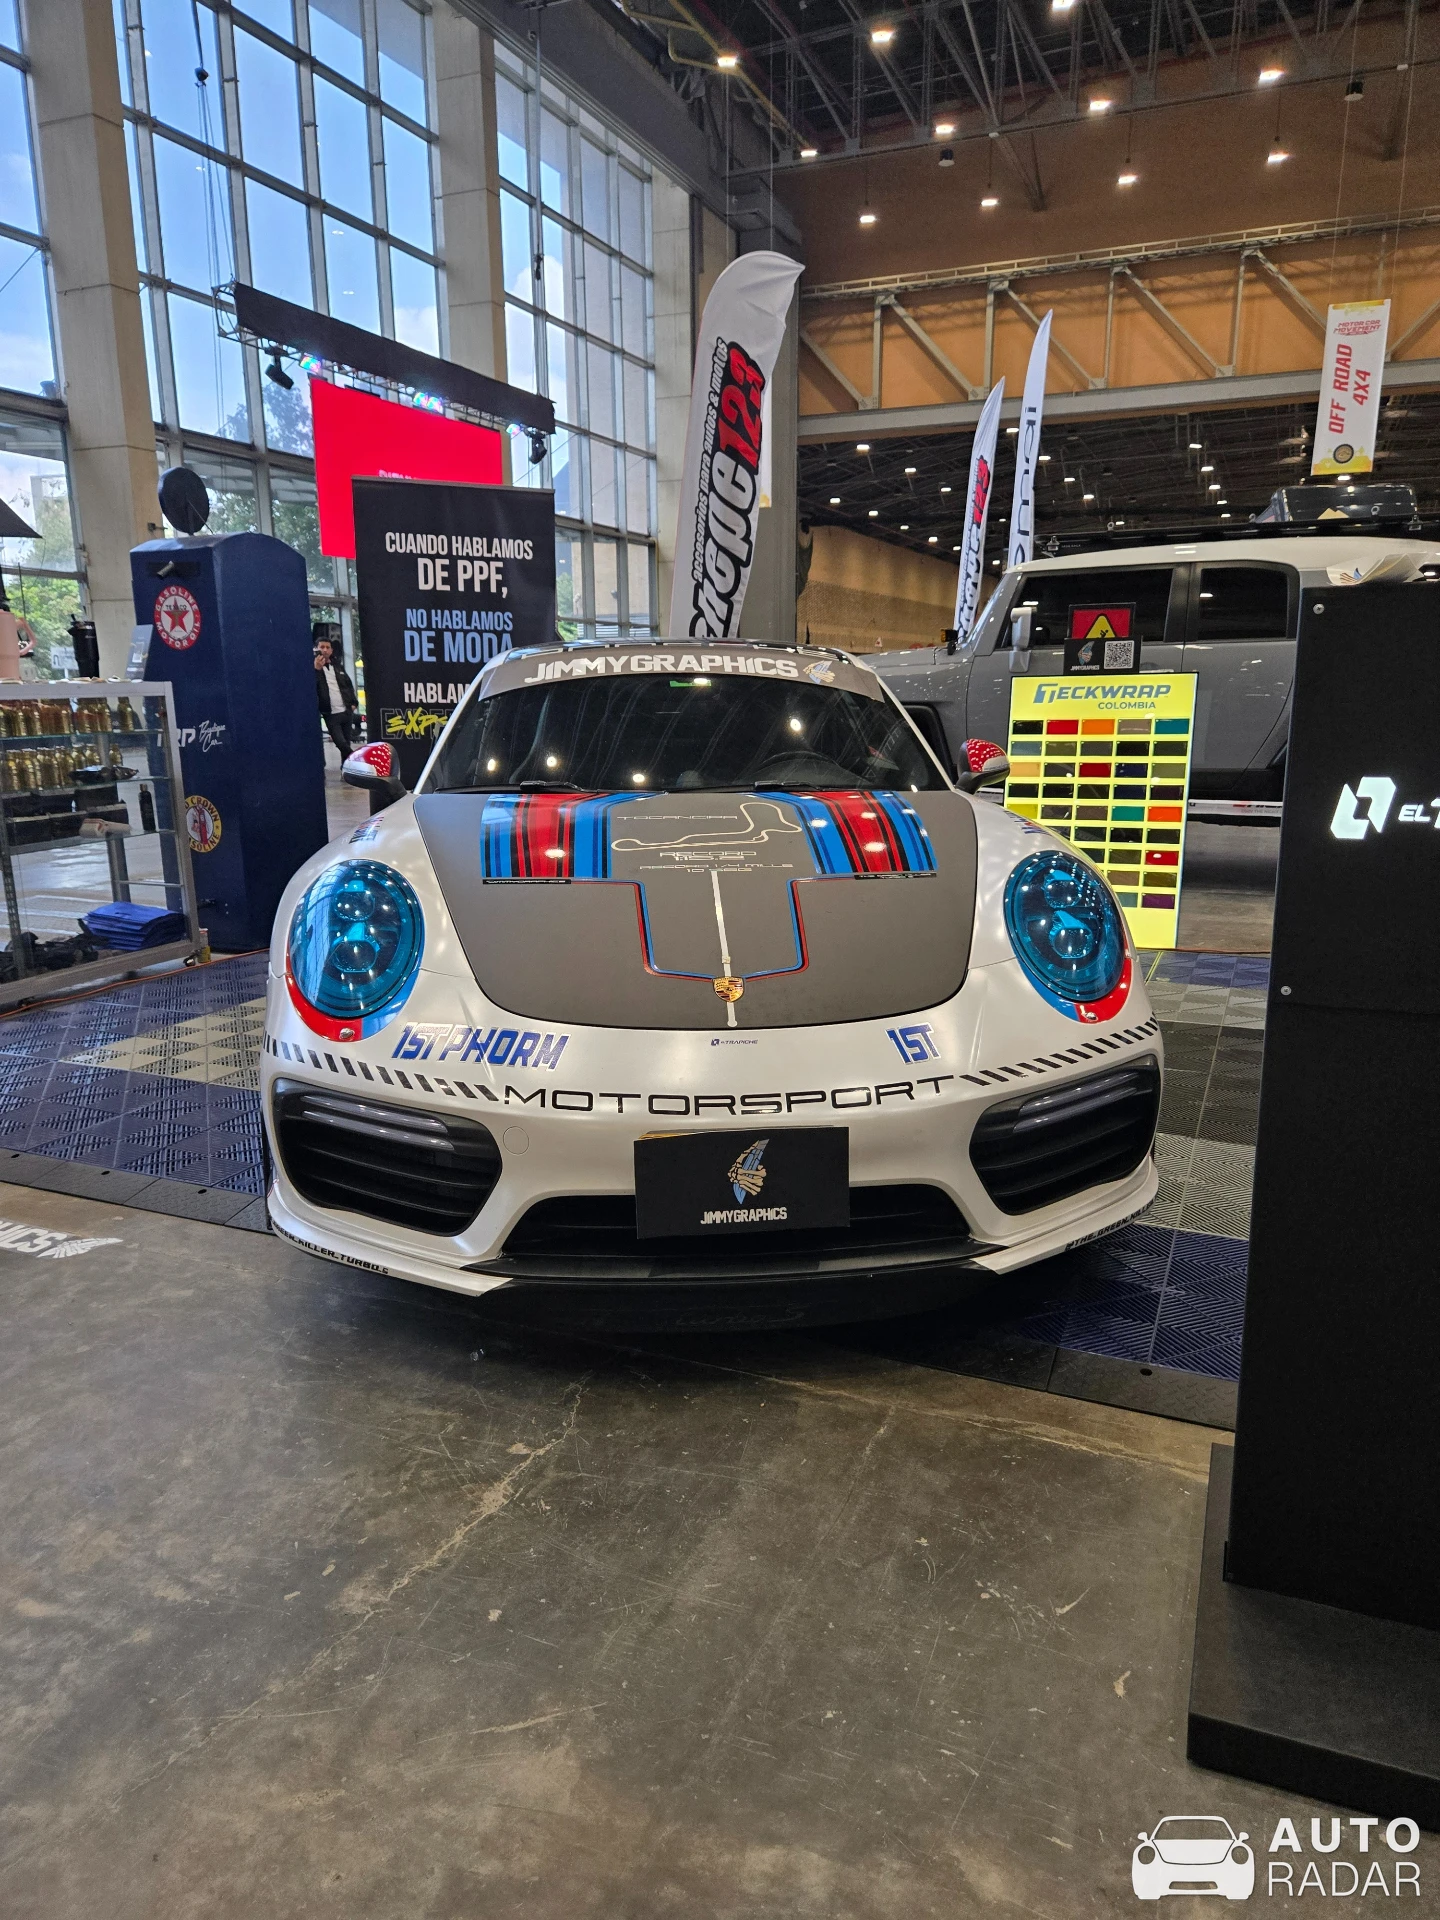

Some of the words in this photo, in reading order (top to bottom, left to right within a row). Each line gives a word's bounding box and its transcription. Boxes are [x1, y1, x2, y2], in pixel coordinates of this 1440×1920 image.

[1333, 325, 1381, 333] MOVEMENT
[711, 338, 728, 394] motos
[1333, 343, 1352, 392] ROAD
[1352, 369, 1371, 405] 4X4
[703, 405, 717, 455] autos
[1328, 398, 1346, 434] OFF
[700, 455, 712, 491] para
[385, 531, 448, 555] CUANDO
[451, 535, 533, 560] HABLAMOS
[693, 491, 709, 584] accesorios
[417, 558, 451, 591] DE
[457, 559, 508, 599] PPF,
[155, 586, 199, 611] GASOLINE
[156, 621, 189, 648] MOTOR
[406, 608, 426, 629] NO
[431, 610, 513, 631] HABLAMOS
[404, 630, 437, 662] DE
[524, 654, 799, 684] JIMMYGRAPHICS
[1097, 701, 1156, 710] COLOMBIA
[190, 796, 221, 822] CROWN
[1398, 804, 1431, 822] EL
[188, 833, 221, 853] SOLINE
[885, 1022, 942, 1065] 1ST
[504, 1075, 955, 1116] MOTORSPORT
[700, 1207, 788, 1225] JIMMYGRAPHICS
